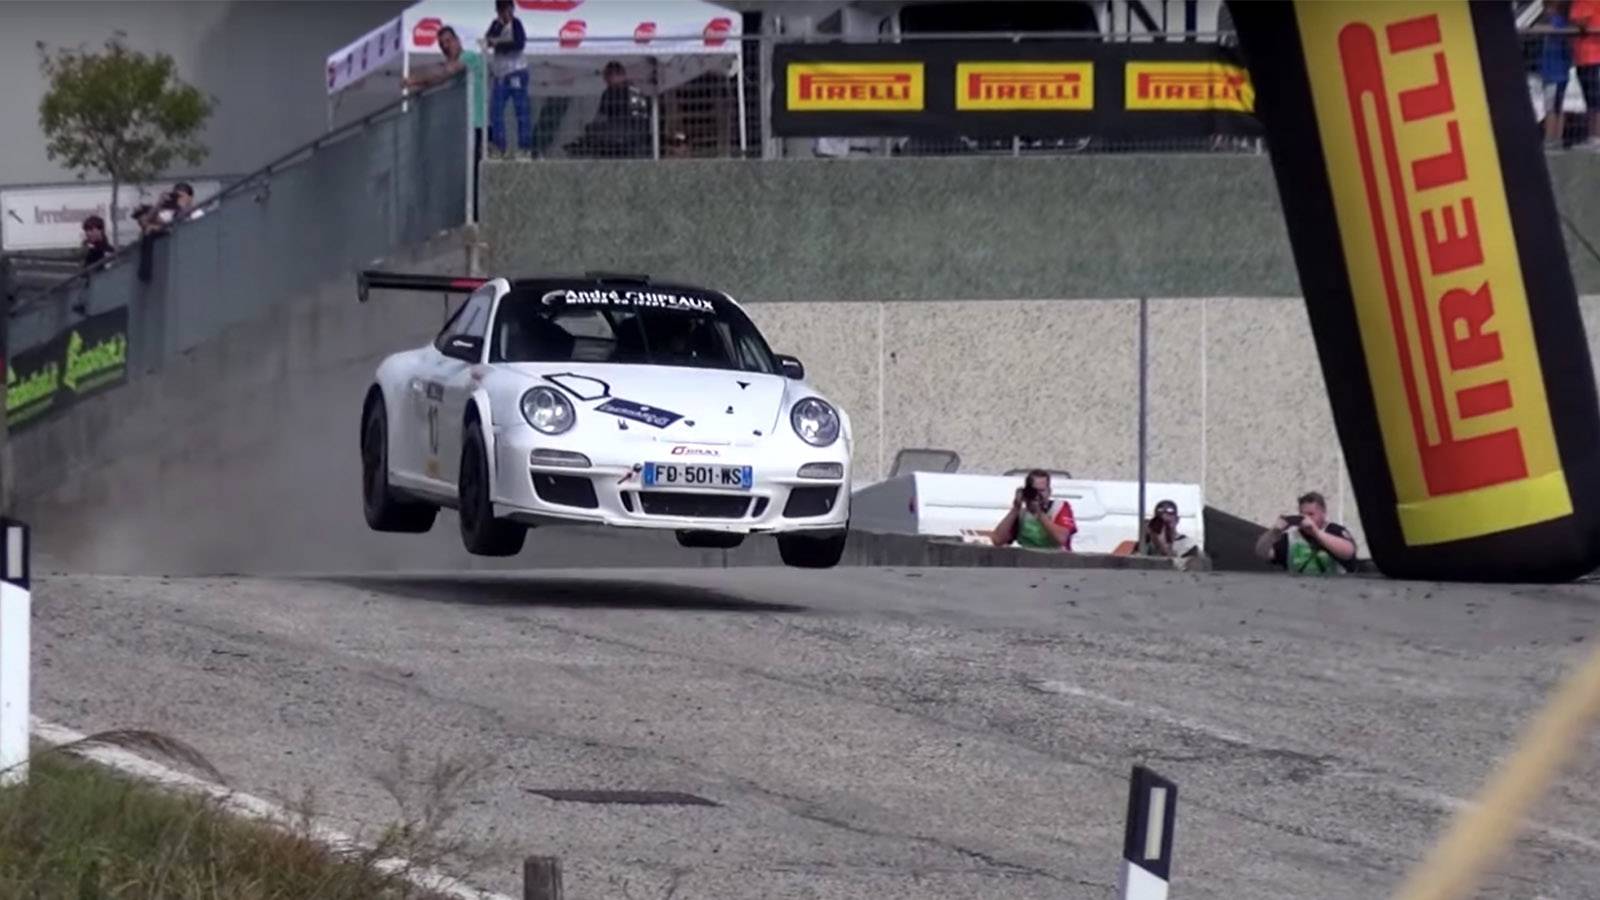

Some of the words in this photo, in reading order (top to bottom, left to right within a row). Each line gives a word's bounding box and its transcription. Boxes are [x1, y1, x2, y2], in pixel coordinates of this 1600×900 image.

[798, 74, 911, 101] PIRELLI
[967, 73, 1081, 100] PIRELLI
[1338, 14, 1529, 497] PIRELLI
